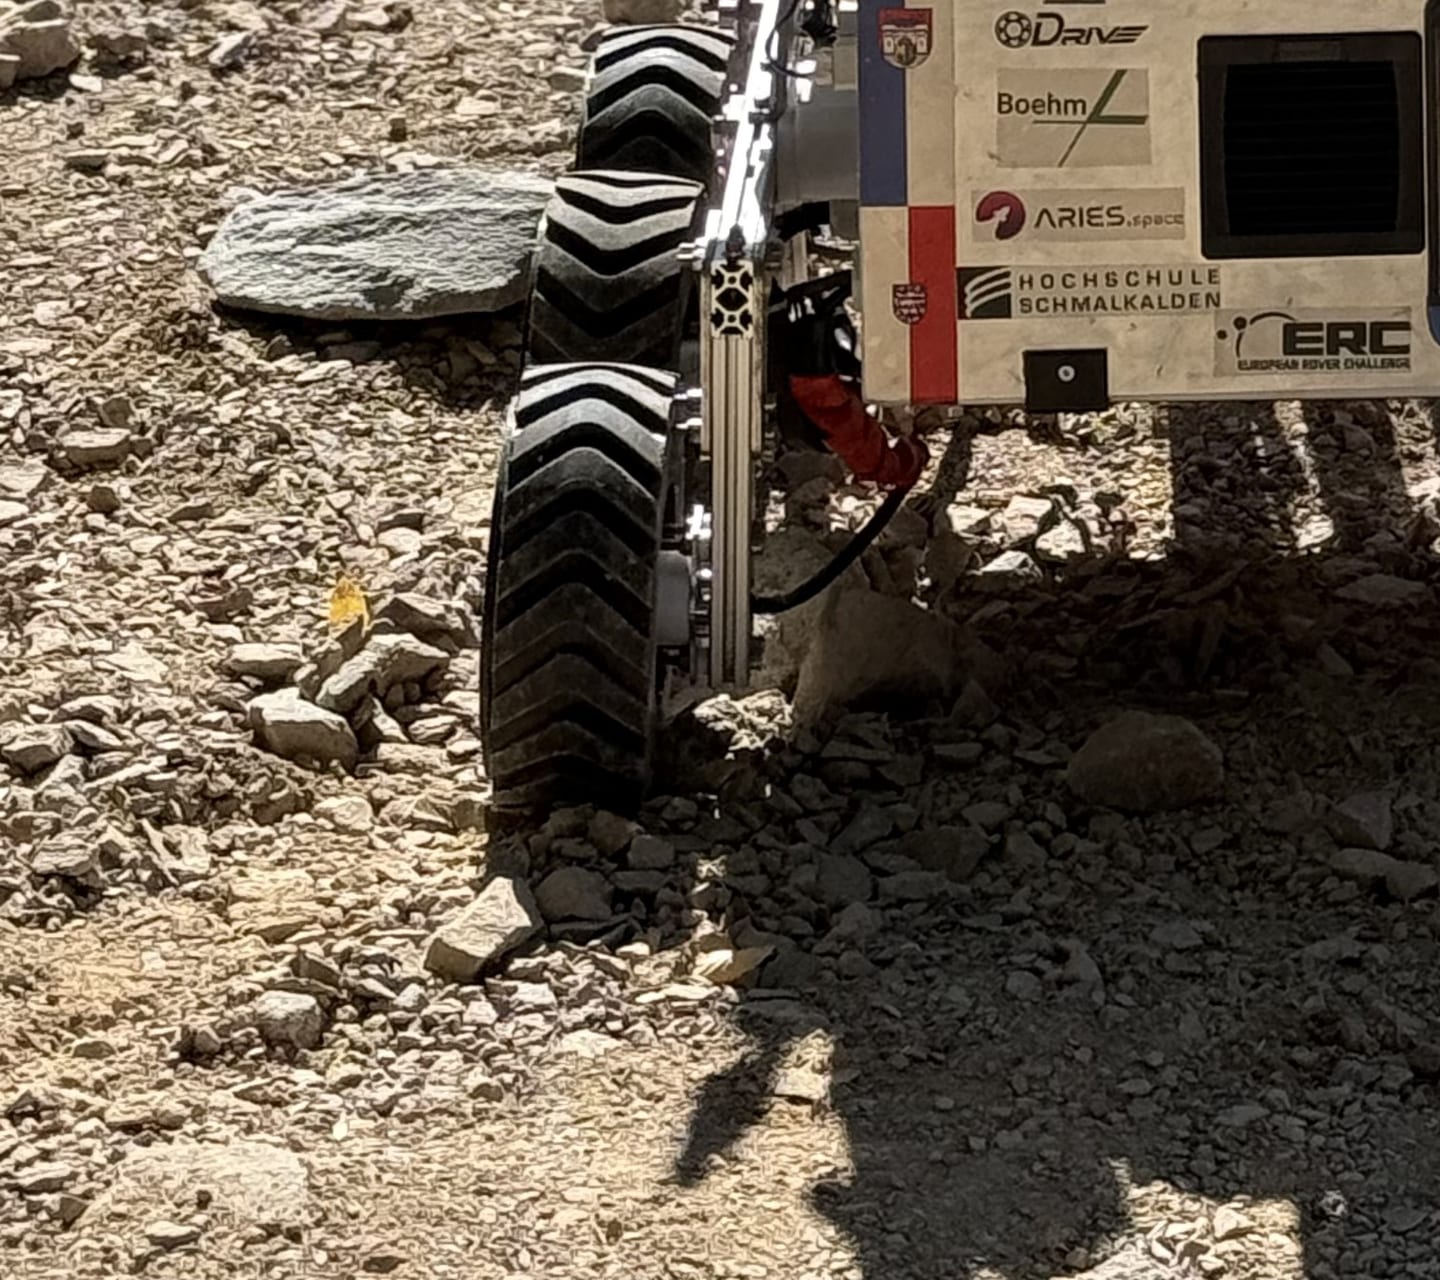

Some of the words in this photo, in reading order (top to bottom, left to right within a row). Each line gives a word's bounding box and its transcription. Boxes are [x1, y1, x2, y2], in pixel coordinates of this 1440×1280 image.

[997, 92, 1086, 115] Boehm
[1019, 268, 1220, 290] HOCHSCHULE
[1019, 292, 1221, 314] SCHMALKALDEN
[1283, 321, 1411, 355] ERC
[1238, 359, 1299, 371] EUROPEAN
[1302, 358, 1340, 370] ROVER
[1344, 357, 1410, 370] CHALLENGE
